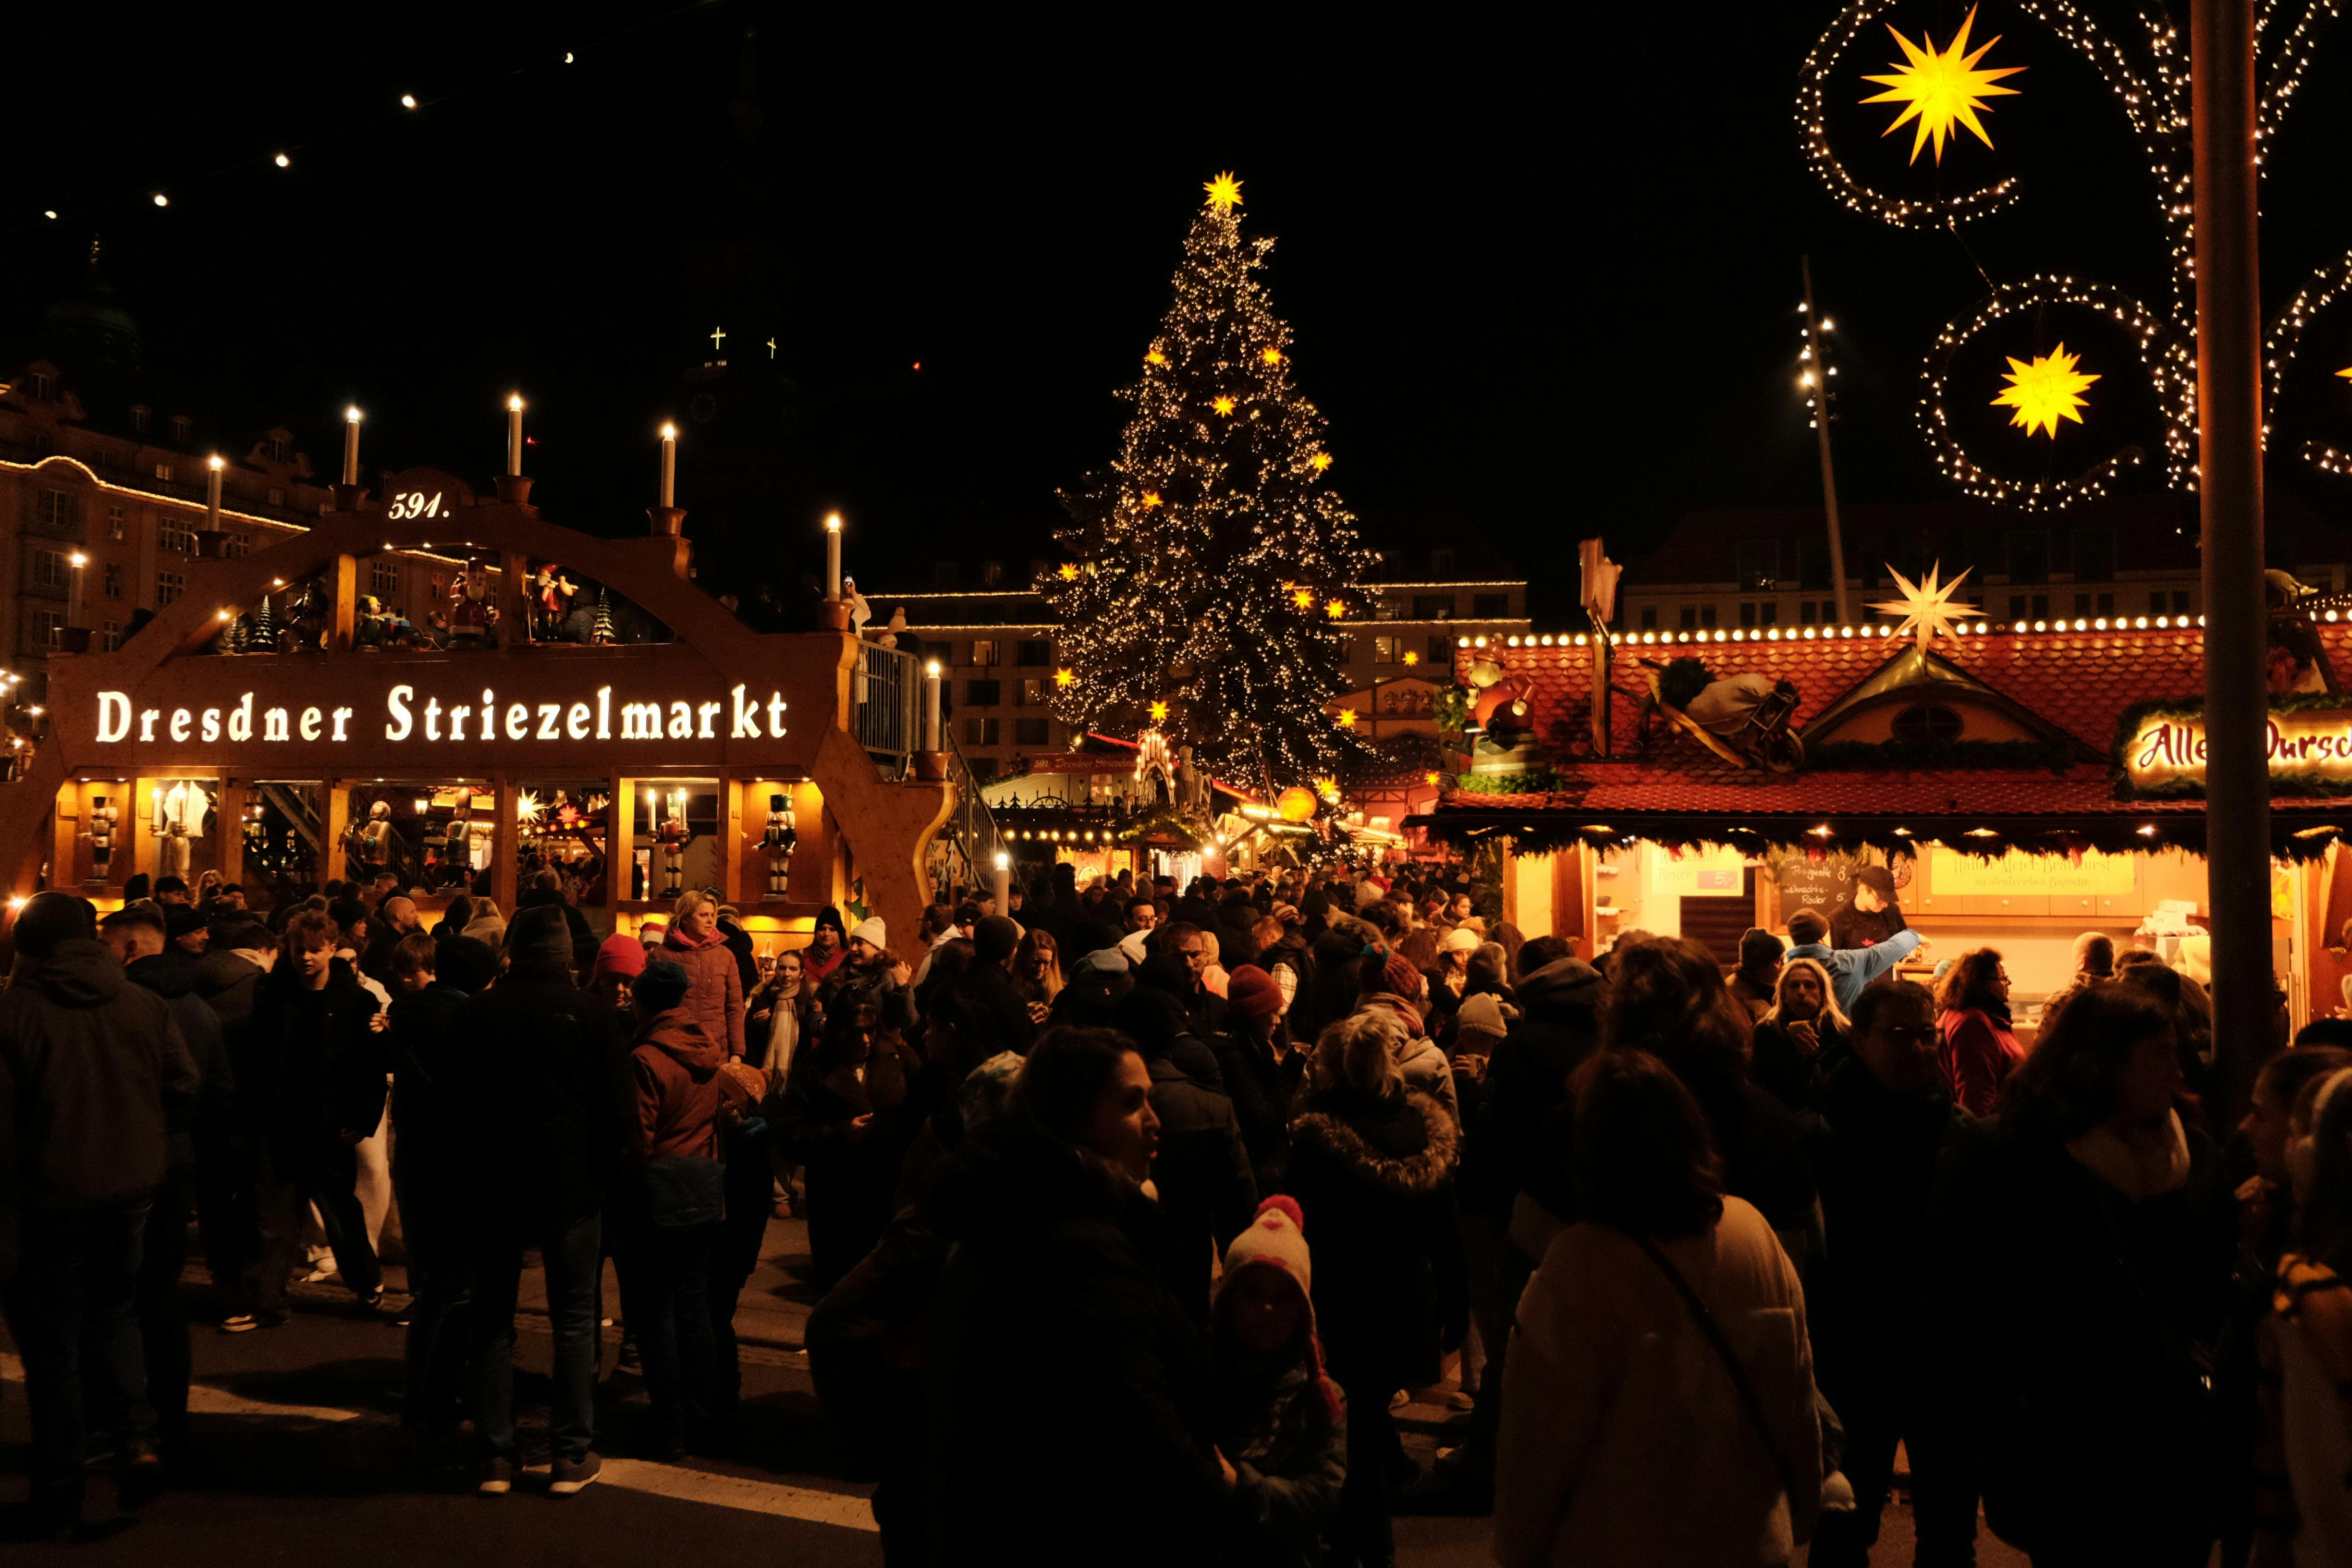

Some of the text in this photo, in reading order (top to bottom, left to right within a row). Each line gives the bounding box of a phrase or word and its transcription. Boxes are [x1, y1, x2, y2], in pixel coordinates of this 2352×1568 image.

[388, 491, 450, 519] 591.
[95, 683, 787, 743] Dresdner Striezelmarkt
[2138, 723, 2206, 768] Alle
[1095, 757, 1137, 768] Striezelma
[1790, 865, 1831, 881] Baguette
[1953, 857, 1997, 873] Halbr
[2042, 857, 2111, 873] Braturst
[1989, 875, 2046, 886] ofenfrischen
[2048, 876, 2090, 888] Baguette
